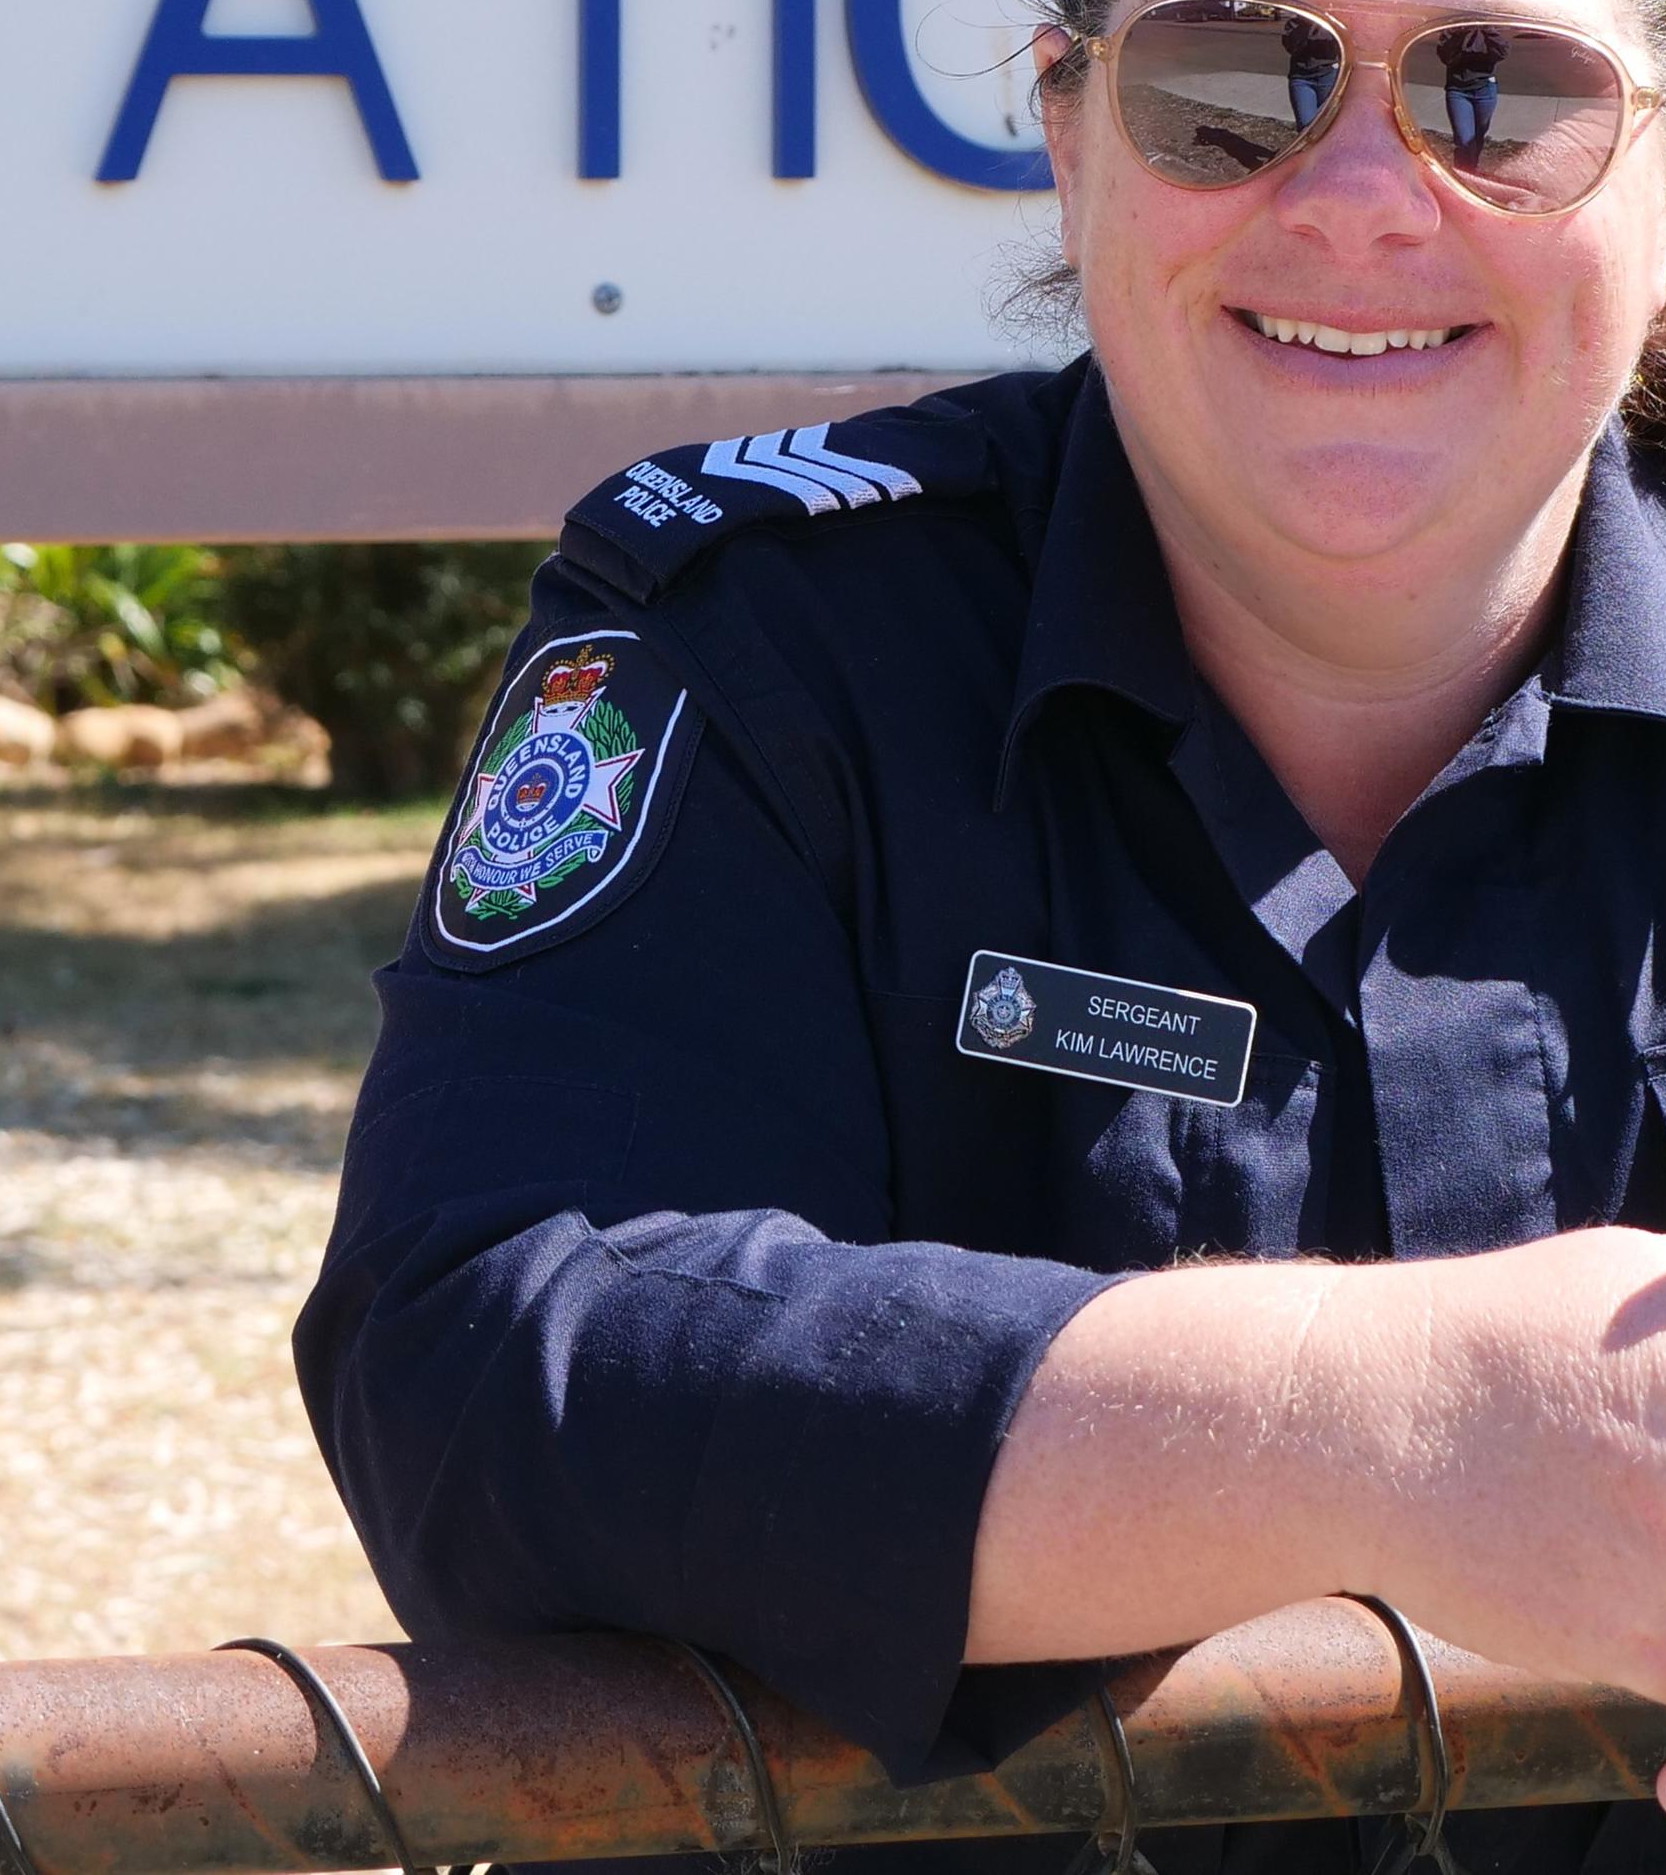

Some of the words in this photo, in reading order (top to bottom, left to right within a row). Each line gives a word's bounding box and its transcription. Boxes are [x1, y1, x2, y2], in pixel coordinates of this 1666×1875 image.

[613, 485, 677, 528] POLICE
[625, 460, 724, 525] QUEENSLAND
[488, 734, 586, 811] QUEENSLAND
[474, 862, 520, 885] HONOUR
[520, 863, 542, 882] WE
[546, 833, 594, 868] SERVE
[487, 815, 560, 852] POLICE
[1087, 995, 1201, 1036] SERGEANT
[1055, 1029, 1095, 1055] KIM
[1099, 1037, 1219, 1080] LAWRENCE
